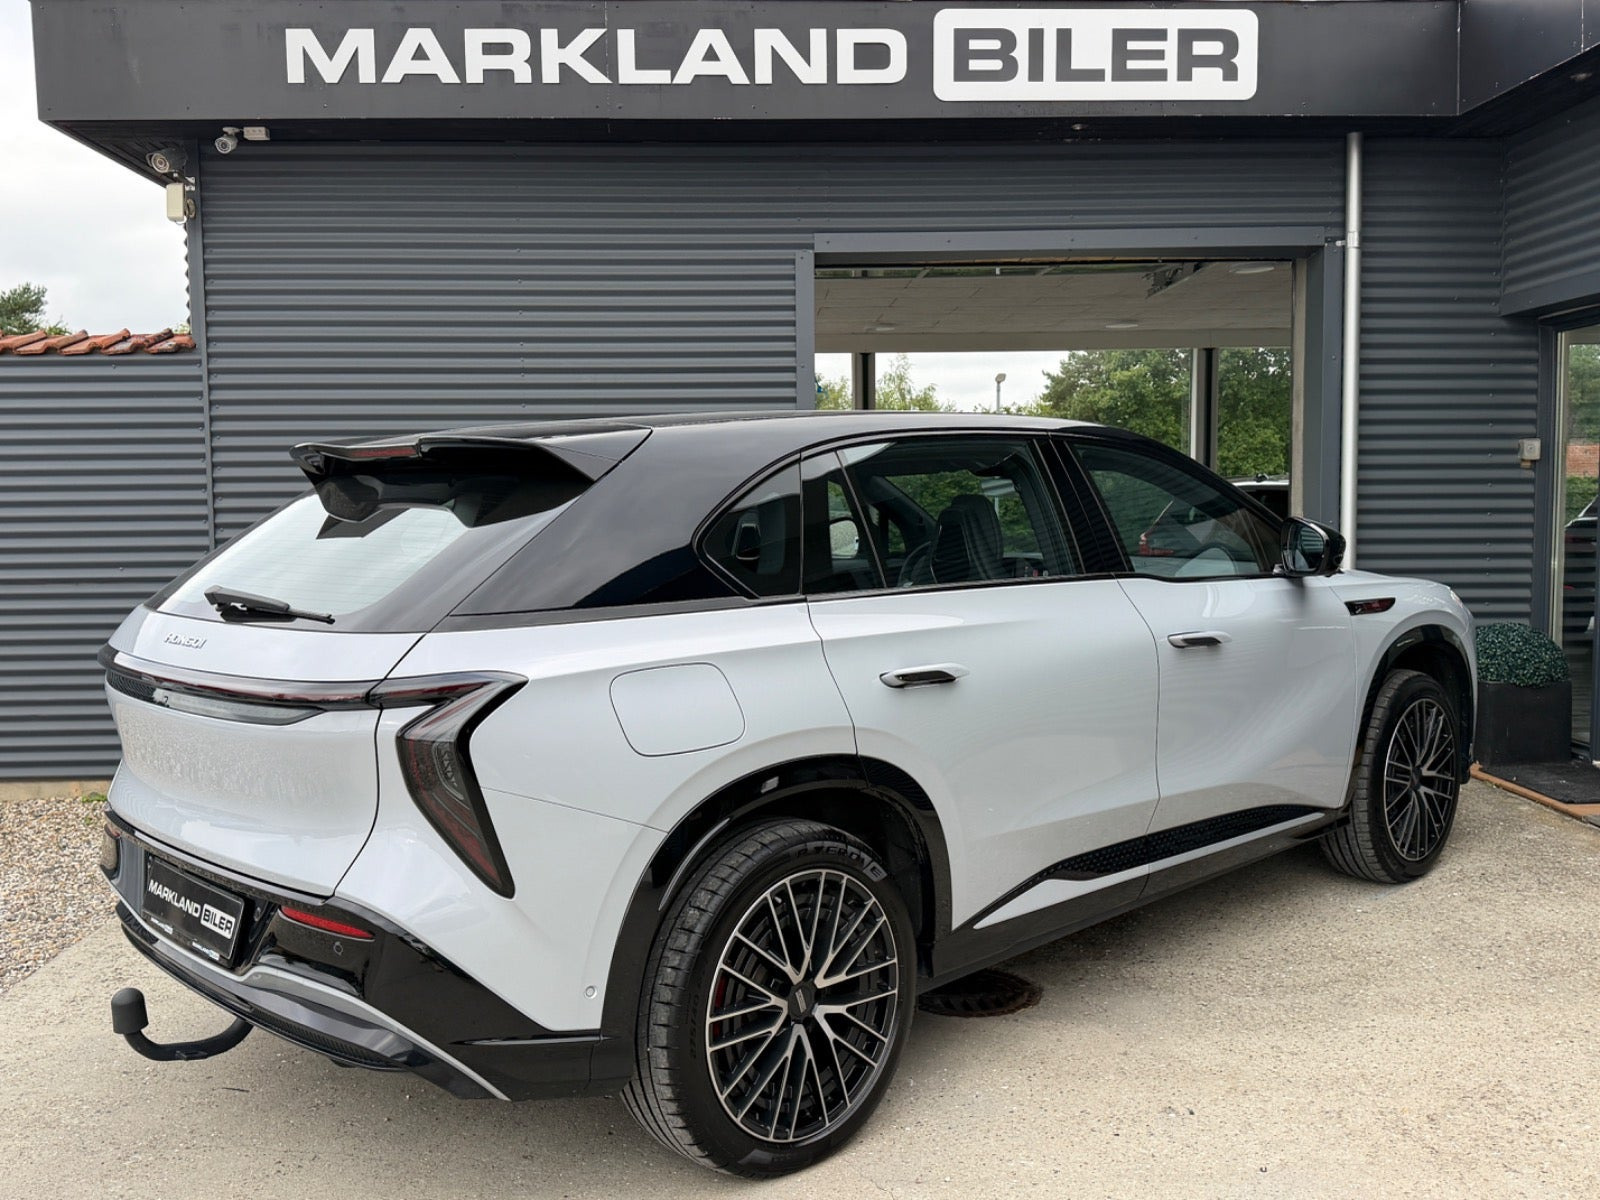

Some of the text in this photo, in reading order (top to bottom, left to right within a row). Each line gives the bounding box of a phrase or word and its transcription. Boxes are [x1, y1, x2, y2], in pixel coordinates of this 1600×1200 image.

[285, 27, 1239, 84] MARKLAND BILER
[148, 879, 201, 918] MARKLAND
[202, 908, 234, 934] BILER
